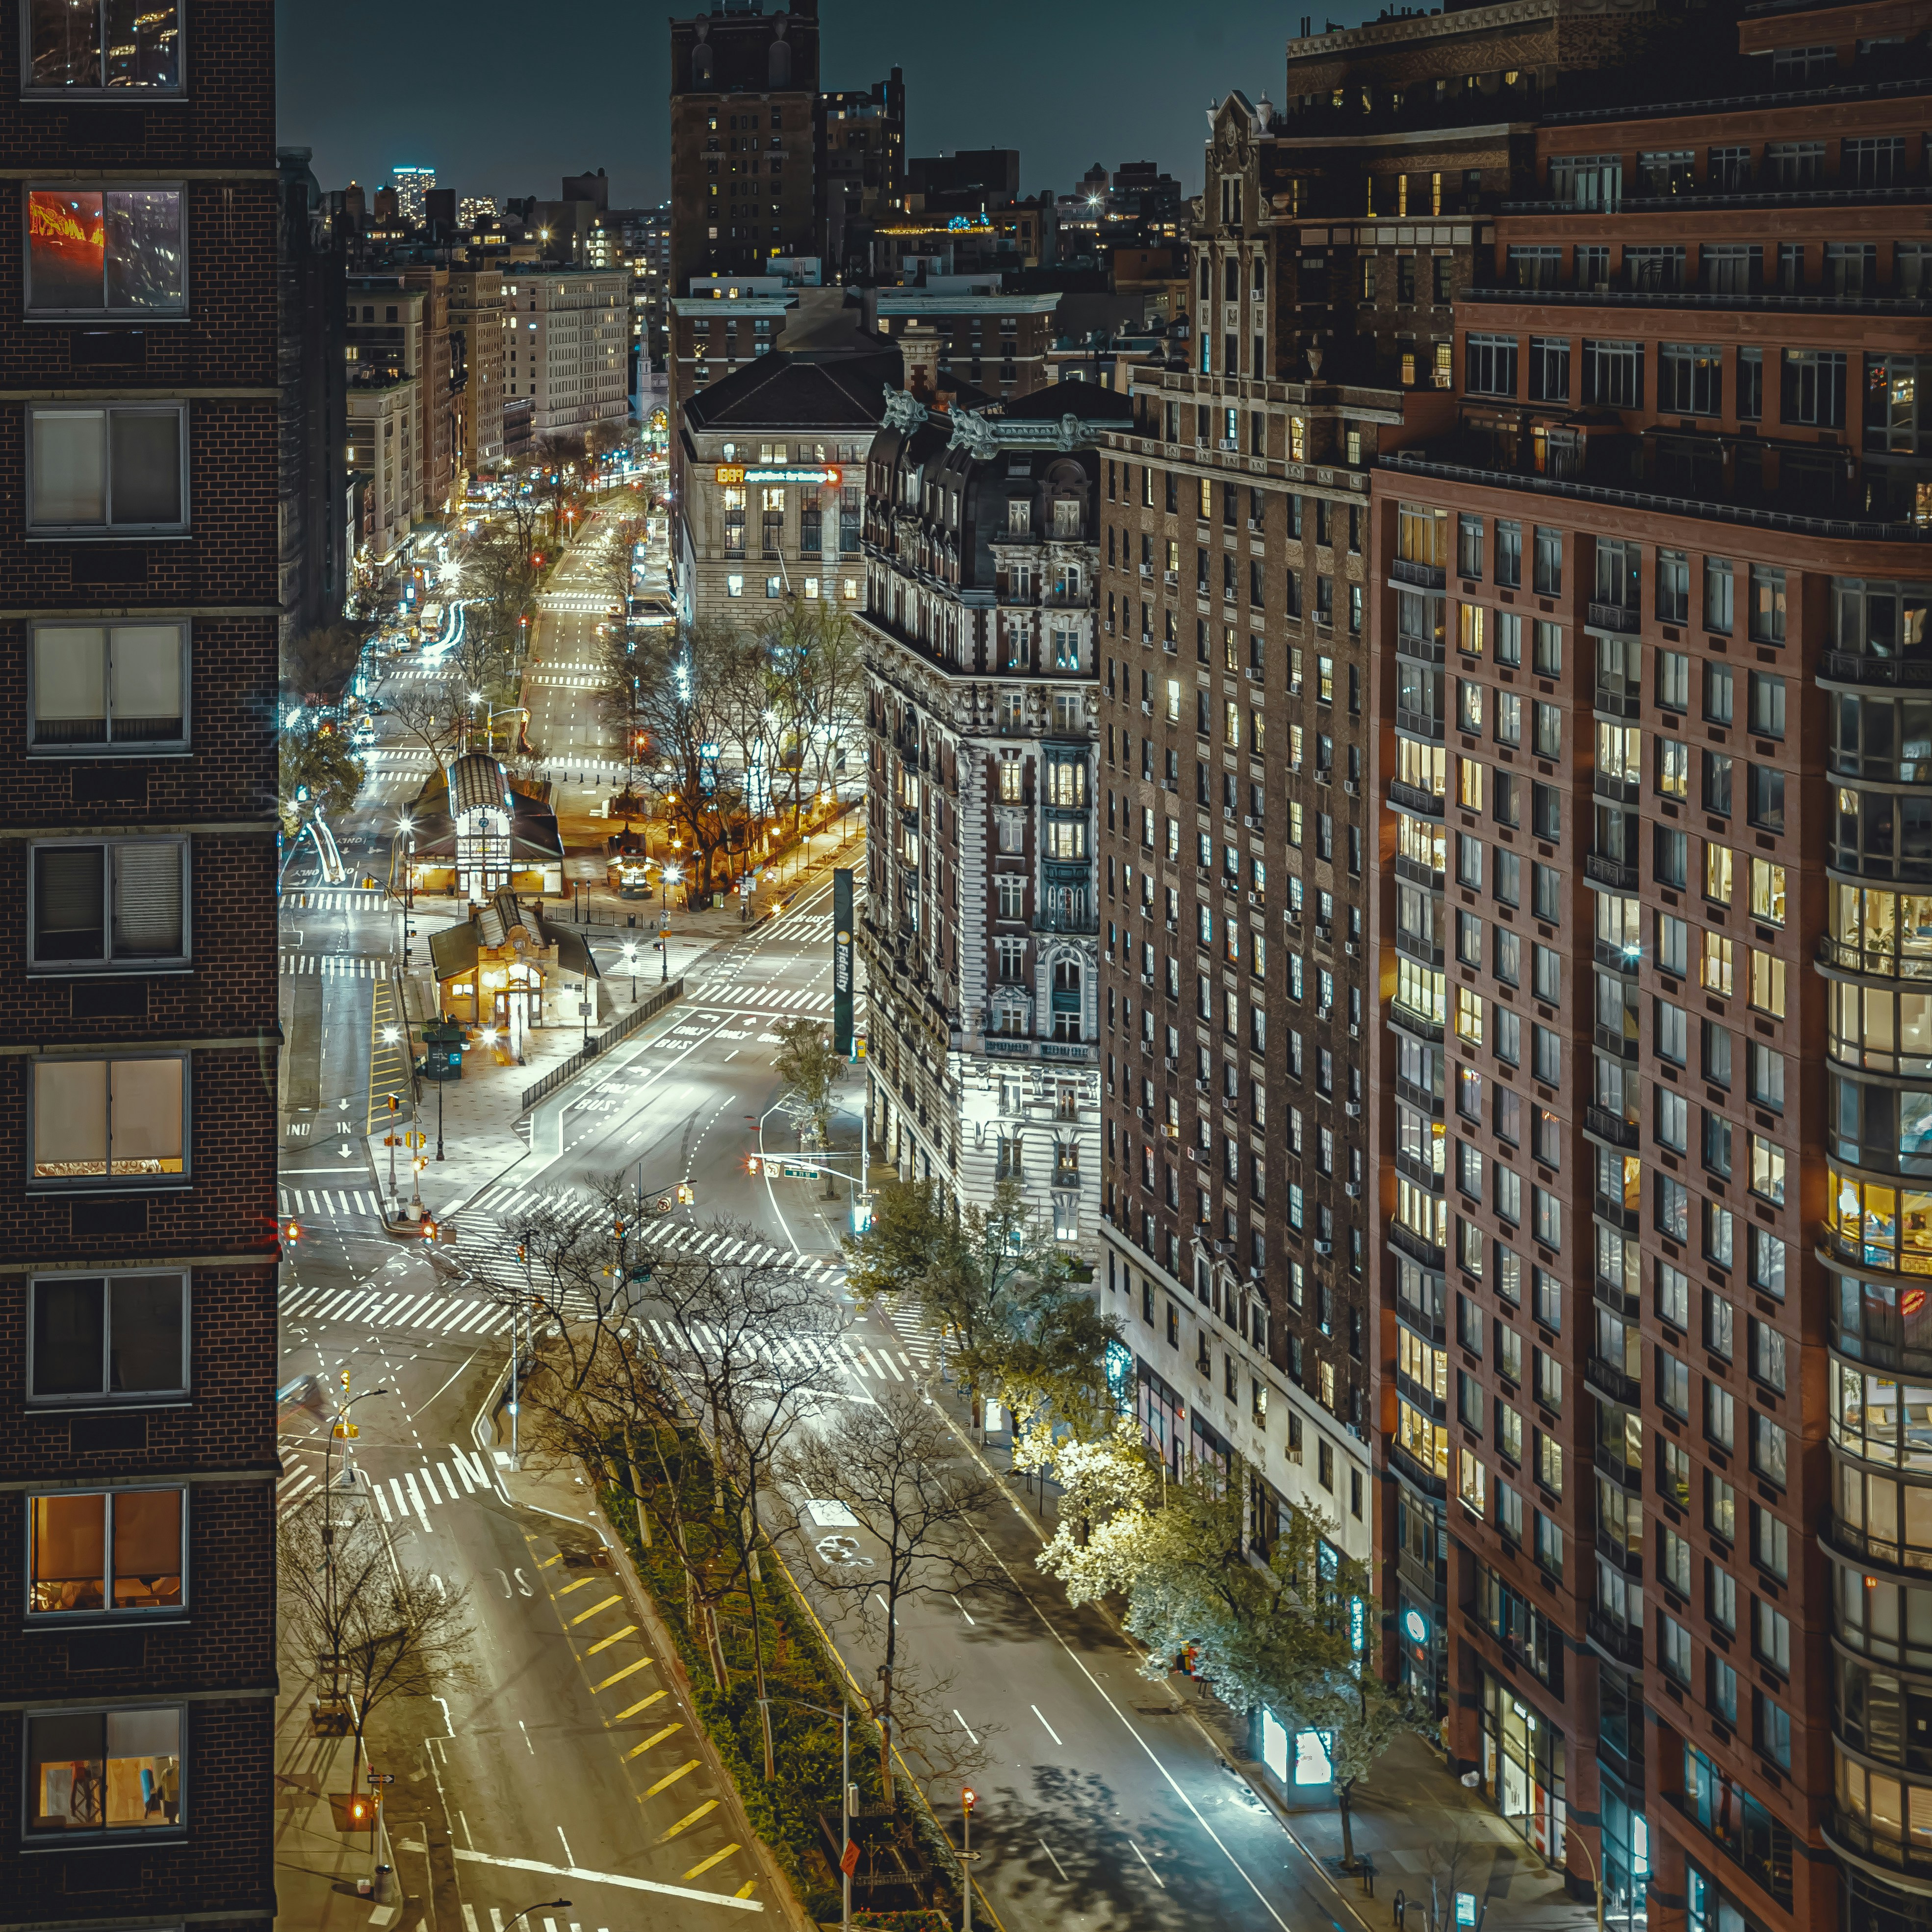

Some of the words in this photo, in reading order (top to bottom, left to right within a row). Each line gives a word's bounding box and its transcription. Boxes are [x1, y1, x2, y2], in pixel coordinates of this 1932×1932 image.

[837, 944, 849, 992] Fidelity
[673, 1025, 711, 1036] ONLY
[715, 1029, 754, 1040] ONLY
[654, 1038, 693, 1050] BUS
[596, 1082, 637, 1095] ONLY
[574, 1099, 617, 1111] BUS
